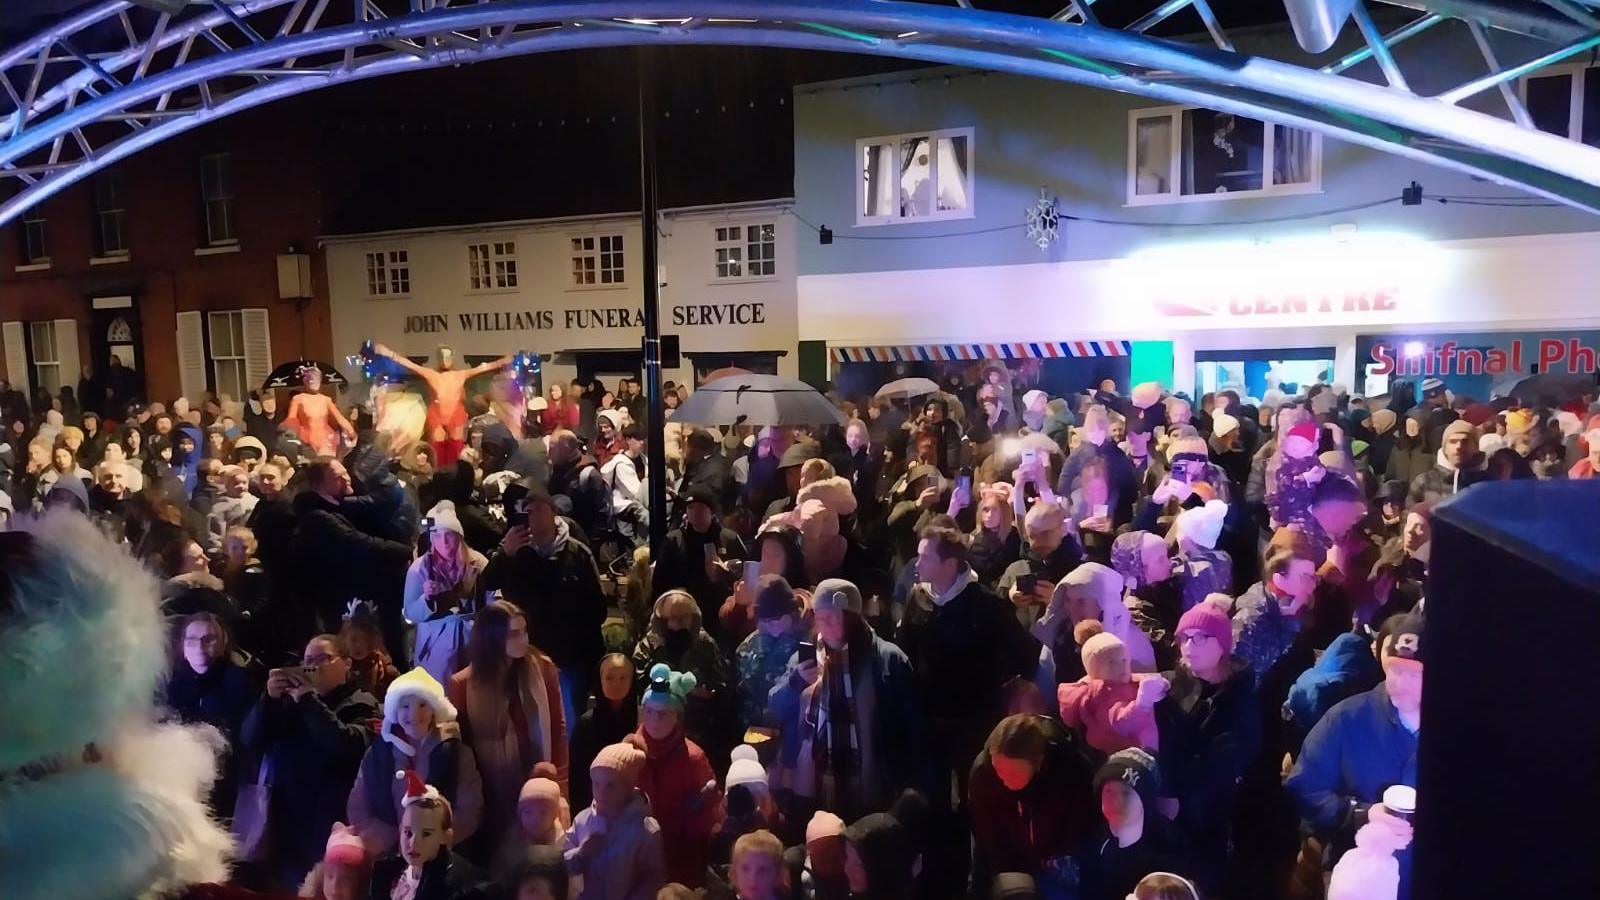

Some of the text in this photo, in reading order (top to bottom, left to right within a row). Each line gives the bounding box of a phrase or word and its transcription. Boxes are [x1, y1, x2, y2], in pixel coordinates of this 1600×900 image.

[403, 303, 766, 334] JOHN WILLIAMS FUNERA SERVICE
[1370, 337, 1600, 376] Shifnal Ph
